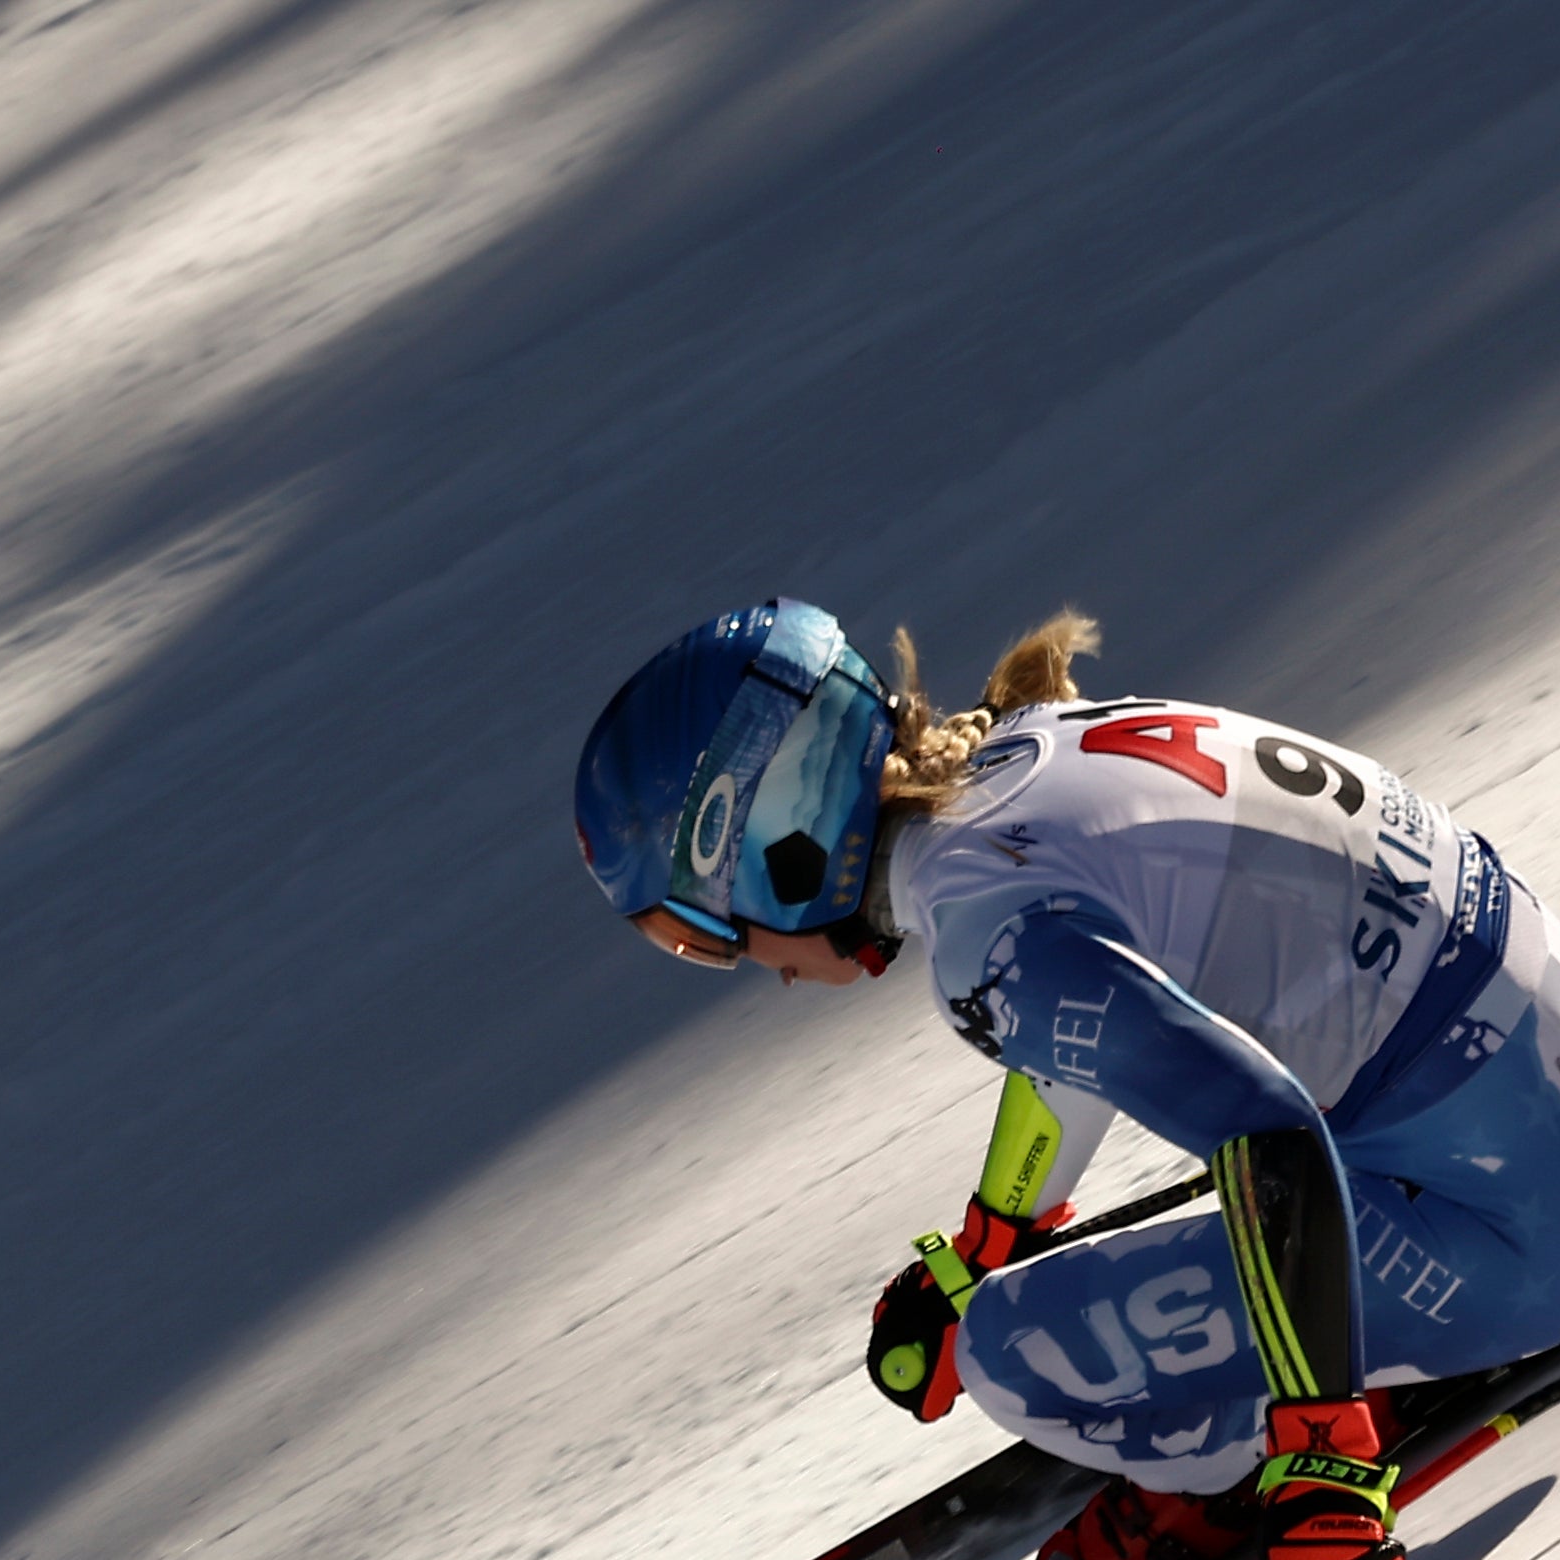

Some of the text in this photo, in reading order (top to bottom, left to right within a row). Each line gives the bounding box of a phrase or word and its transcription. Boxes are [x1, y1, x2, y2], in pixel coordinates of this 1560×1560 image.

[1255, 736, 1365, 818] 9
[1350, 830, 1433, 982] SKI
[1052, 985, 1116, 1090] IFEL
[1352, 1200, 1466, 1325] TIFEL
[1013, 1264, 1257, 1406] US
[1291, 1456, 1369, 1485] LEKI
